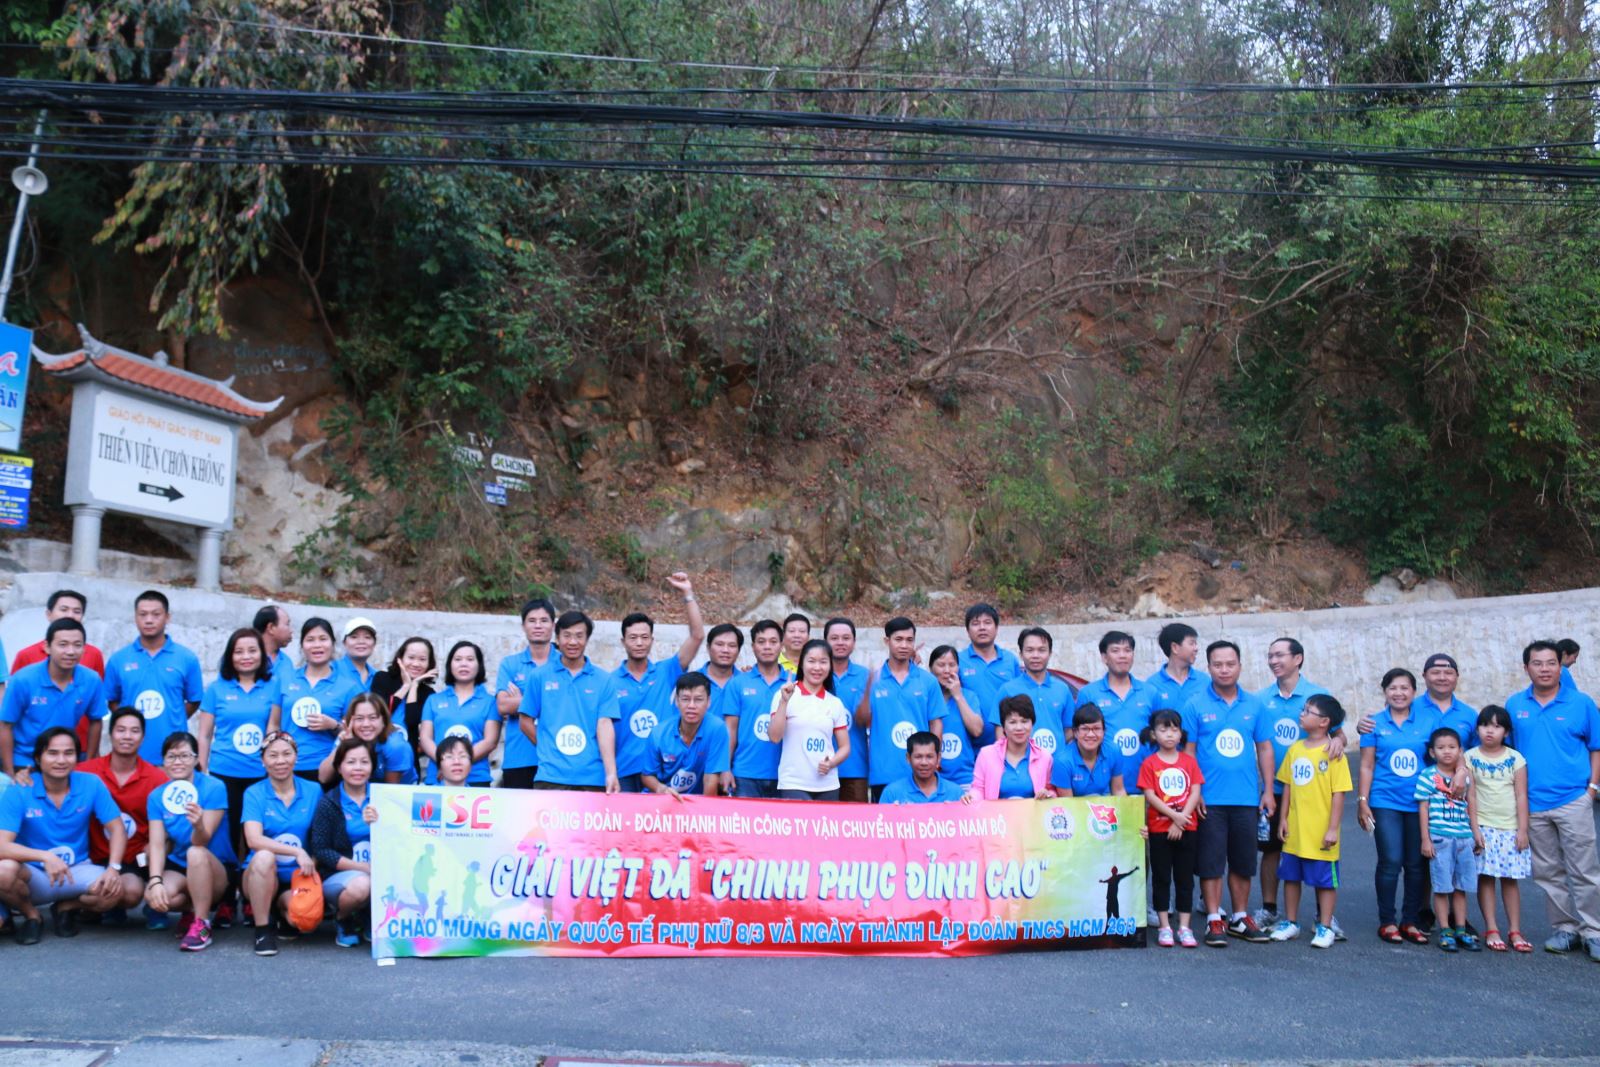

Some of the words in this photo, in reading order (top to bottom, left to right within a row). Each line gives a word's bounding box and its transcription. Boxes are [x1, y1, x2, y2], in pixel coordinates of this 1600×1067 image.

[140, 698, 161, 711] 172
[634, 716, 655, 732] 125
[239, 731, 260, 746] 126
[1277, 724, 1297, 740] 800
[561, 734, 583, 748] 168
[807, 738, 825, 752] 690
[1036, 735, 1054, 749] 059
[1117, 736, 1137, 749] 600
[1220, 737, 1241, 750] 030
[1293, 764, 1311, 778] 146
[1394, 756, 1415, 771] 004
[672, 774, 693, 787] 036
[1163, 775, 1185, 790] 049
[445, 795, 494, 829] SE
[539, 807, 580, 830] CÔNG
[584, 808, 622, 831] ĐOÀN
[634, 809, 672, 833] ĐOÀN
[676, 814, 717, 833] THANH
[720, 811, 750, 834] NIÊN
[753, 813, 792, 836] CÔNG
[794, 818, 808, 836] TY
[811, 815, 839, 840] VẬN
[841, 813, 894, 839] CHUYỂN
[896, 818, 916, 839] KHÍ
[918, 816, 956, 838] ĐÔNG
[958, 817, 988, 837] NAM
[491, 841, 564, 898] GIẢI
[571, 848, 644, 906] VIỆT
[818, 860, 897, 908] PHỤC
[905, 849, 979, 900] ĐỈNH
[388, 912, 437, 938] CHÀO
[507, 915, 562, 942] NGÀY
[568, 914, 624, 943] QUỐC
[628, 914, 655, 943] TẾ
[658, 922, 699, 949] PHỤ
[703, 918, 733, 943] NỮ
[736, 922, 764, 944] 8/3
[769, 918, 796, 943] VÀ
[801, 917, 854, 943] NGÀY
[859, 916, 924, 943] THÀNH
[929, 917, 964, 946] LẬP
[968, 916, 1017, 941] ĐOÀN
[1022, 919, 1065, 939] TNCS
[1069, 917, 1105, 938] HCM
[1106, 916, 1136, 937] 26/3
